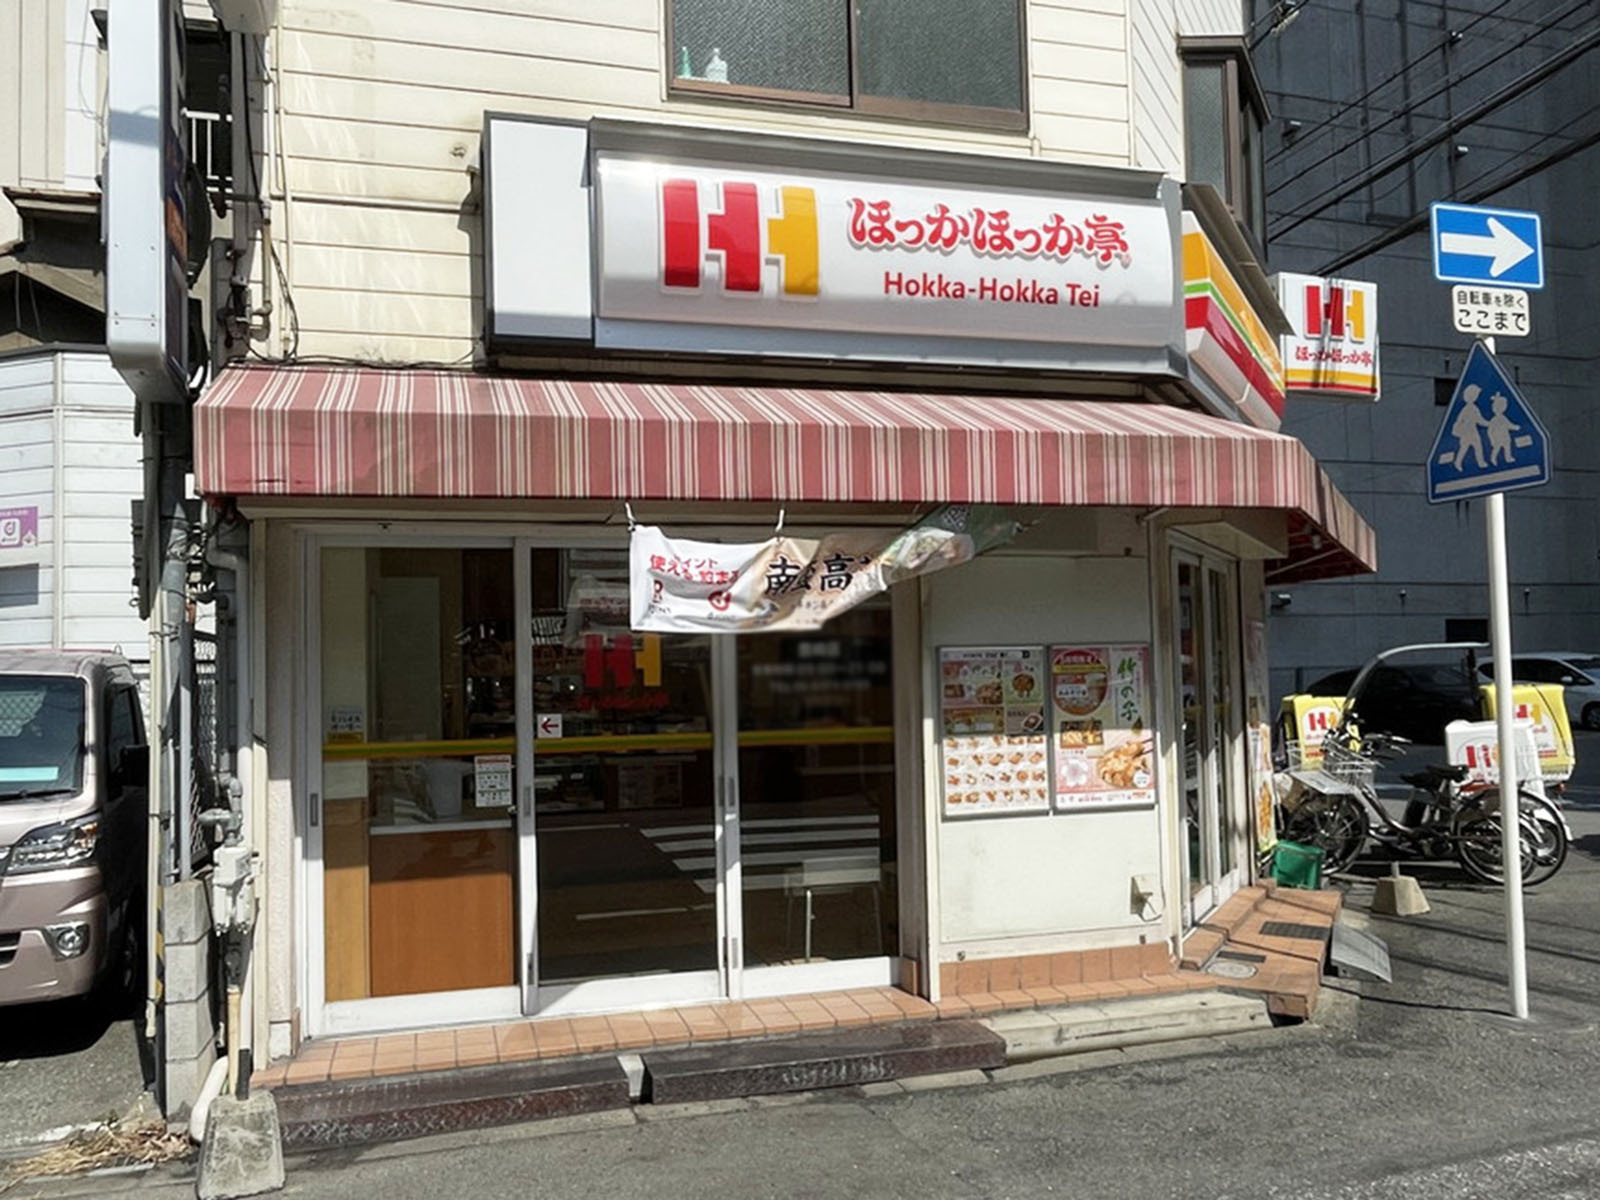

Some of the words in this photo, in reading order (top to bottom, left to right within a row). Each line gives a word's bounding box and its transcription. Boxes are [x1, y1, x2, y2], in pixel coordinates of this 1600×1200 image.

[848, 197, 1130, 264] ほっかほっか亭
[884, 271, 1060, 305] Hokka-Hokka
[1066, 283, 1101, 308] Tei
[1457, 290, 1526, 309] 自転車を除く
[1458, 308, 1528, 332] ここまで
[1295, 345, 1373, 368] ほっかほっか亭
